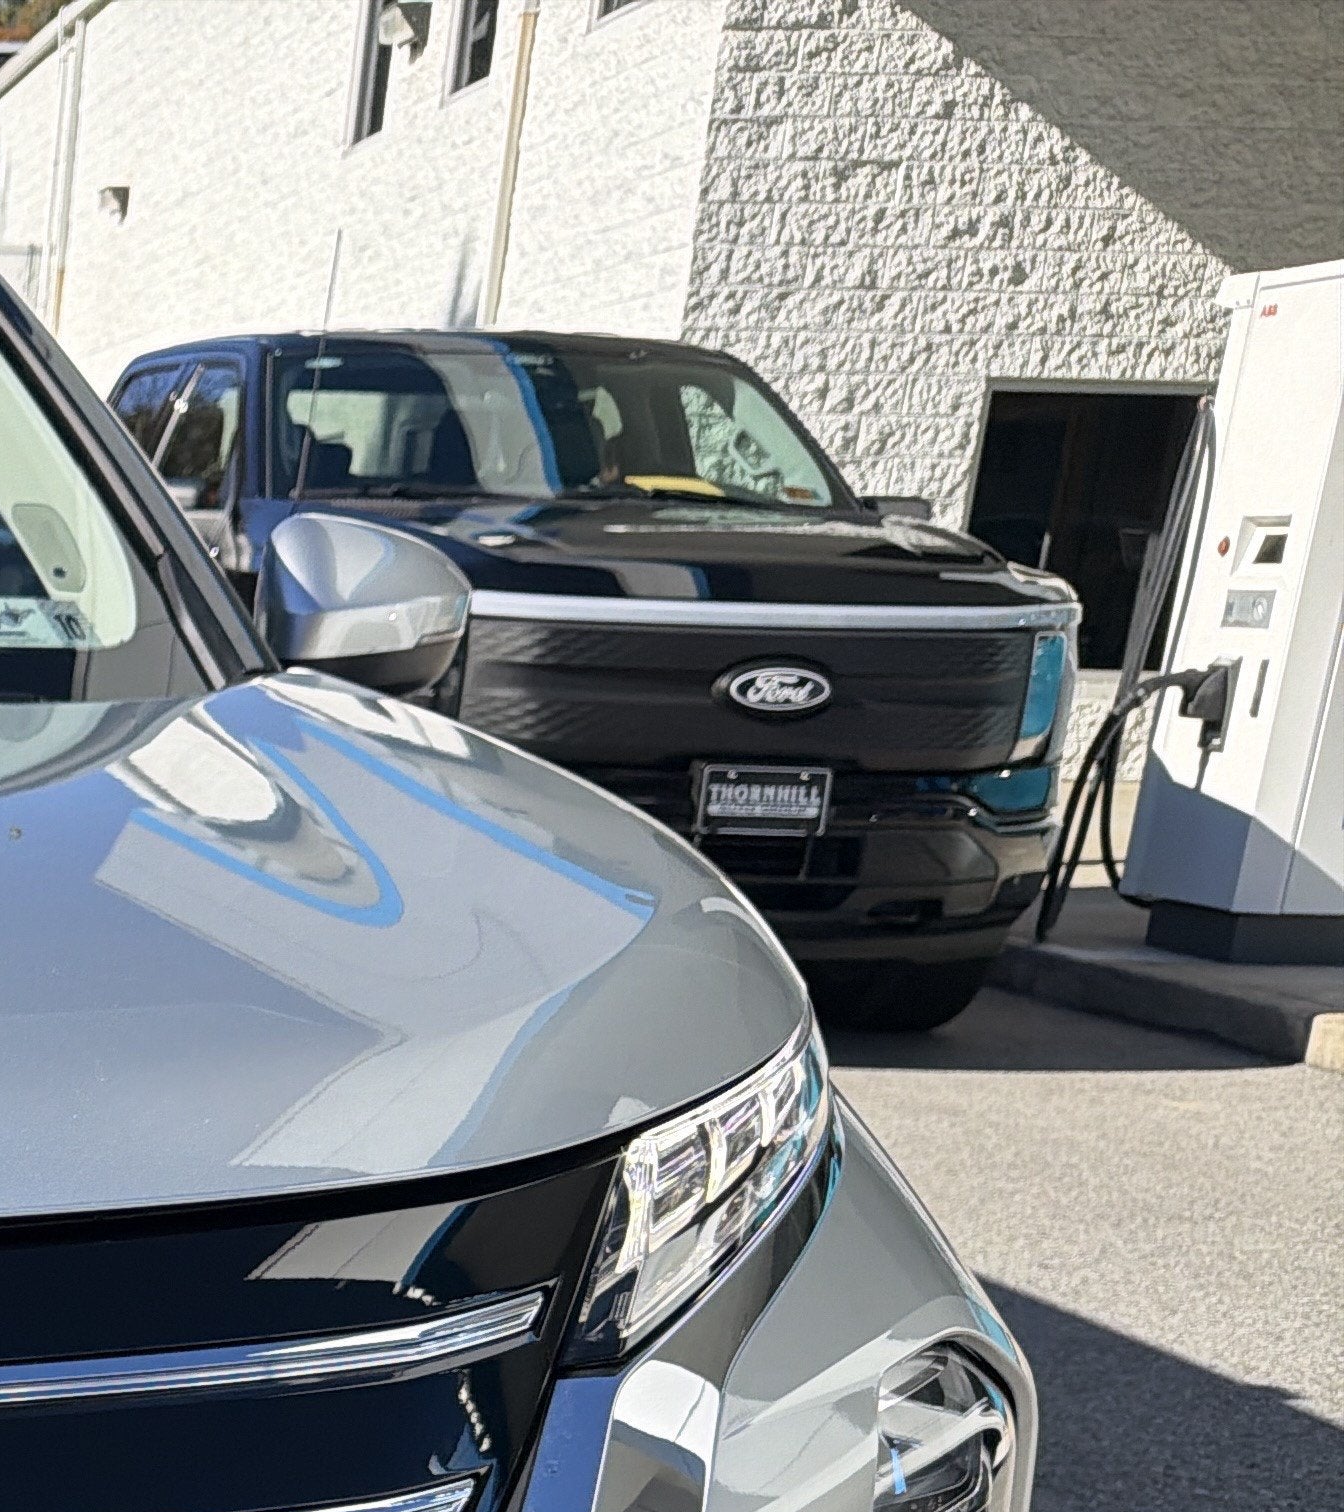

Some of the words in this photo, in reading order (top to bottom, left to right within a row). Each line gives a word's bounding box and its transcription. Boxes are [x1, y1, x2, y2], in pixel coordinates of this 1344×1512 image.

[53, 614, 87, 641] 10
[746, 673, 815, 703] Ford
[707, 783, 822, 806] THORNHILL
